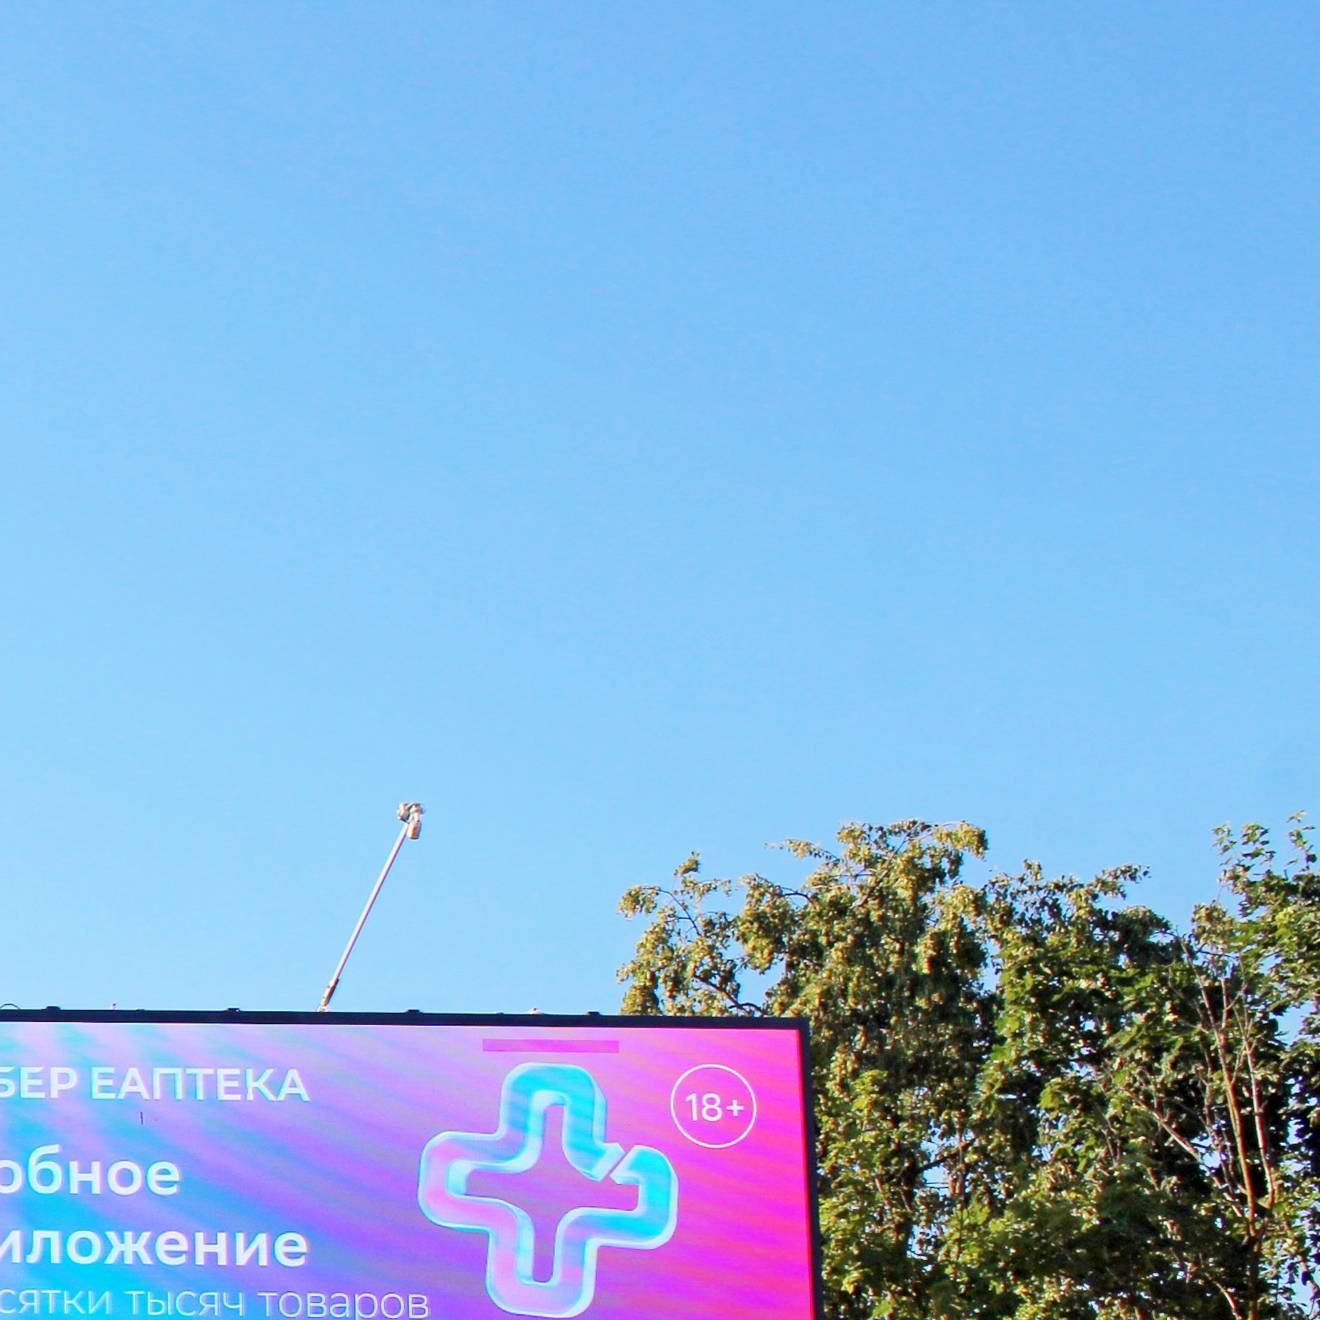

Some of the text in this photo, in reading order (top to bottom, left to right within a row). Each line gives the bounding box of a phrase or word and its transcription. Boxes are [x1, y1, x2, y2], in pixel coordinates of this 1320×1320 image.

[91, 1067, 311, 1102] ЕАПТЕКА
[685, 1093, 745, 1122] 18+
[124, 1290, 245, 1317] тысяч
